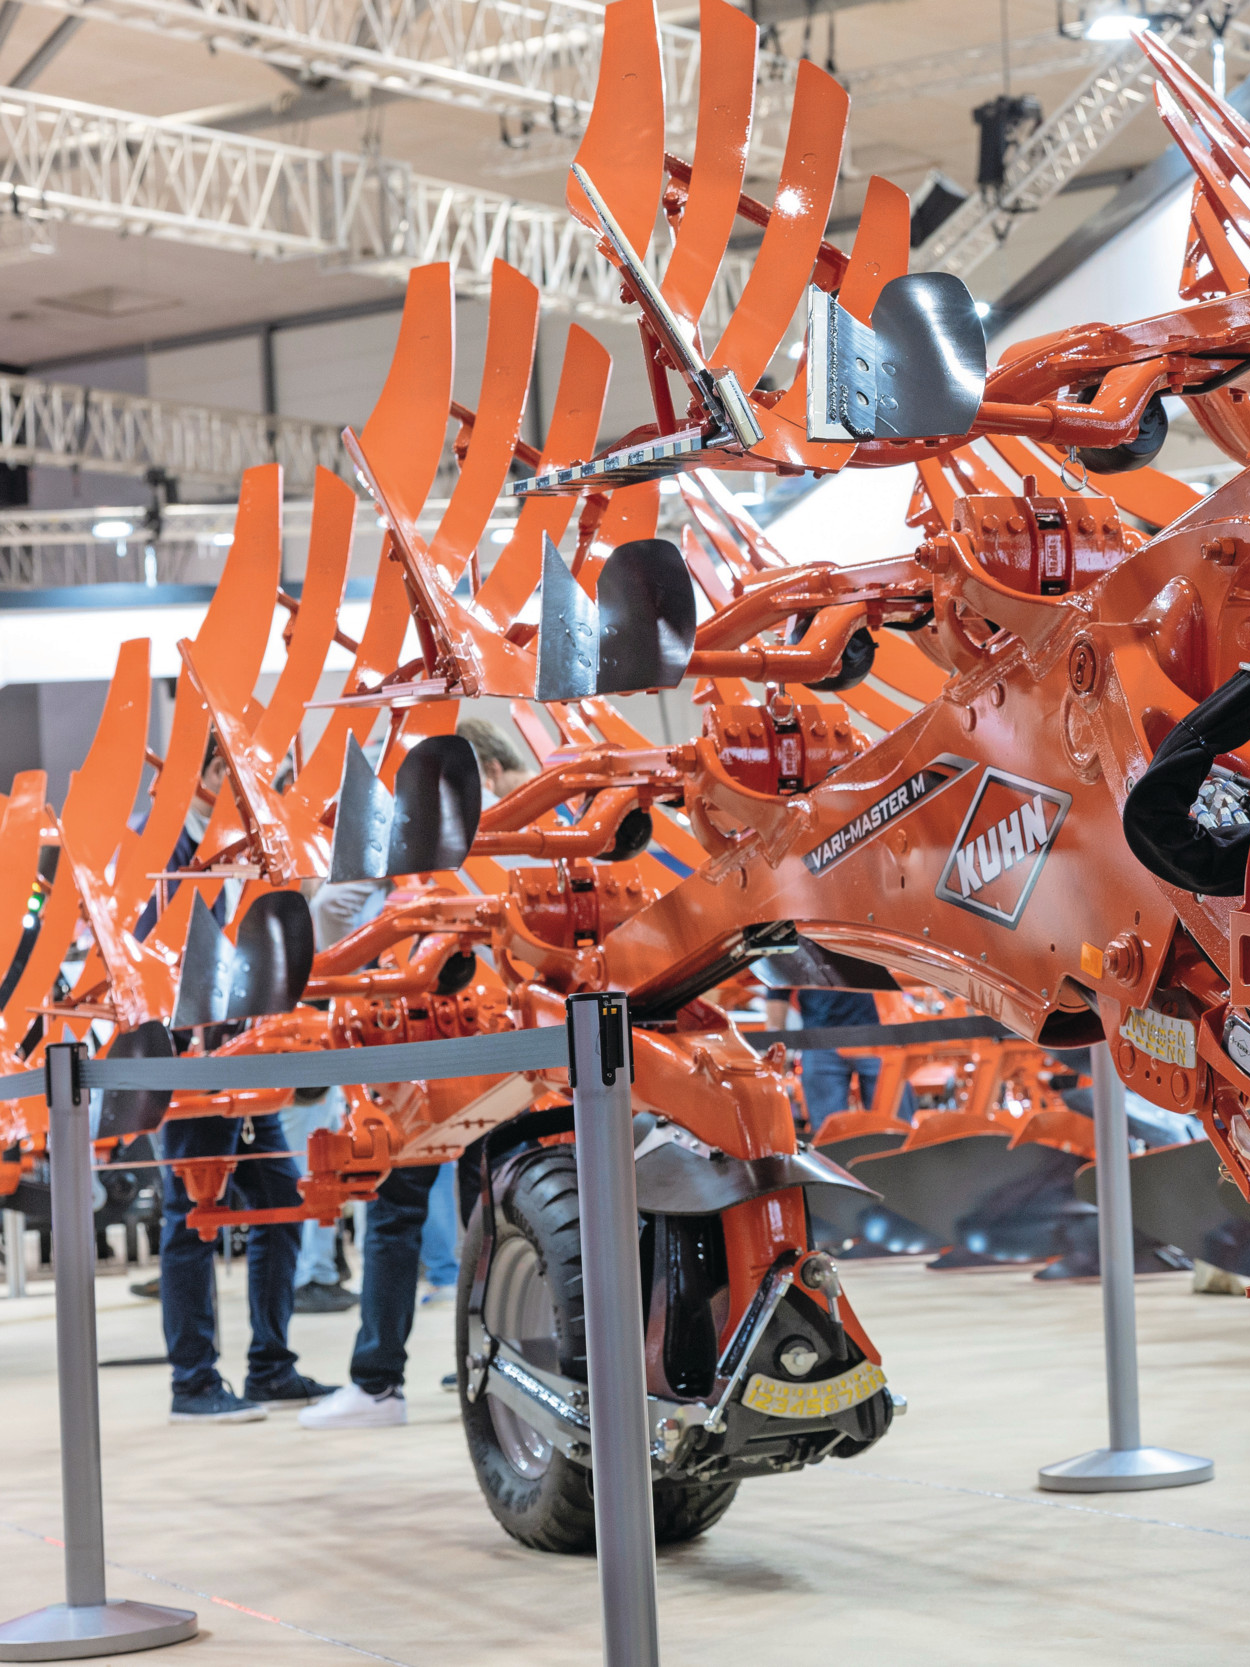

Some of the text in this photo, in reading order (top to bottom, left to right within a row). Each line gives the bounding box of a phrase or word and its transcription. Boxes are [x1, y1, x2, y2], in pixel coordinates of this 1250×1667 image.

[811, 773, 926, 869] VARI-MASTER M
[955, 794, 1048, 899] KUHN
